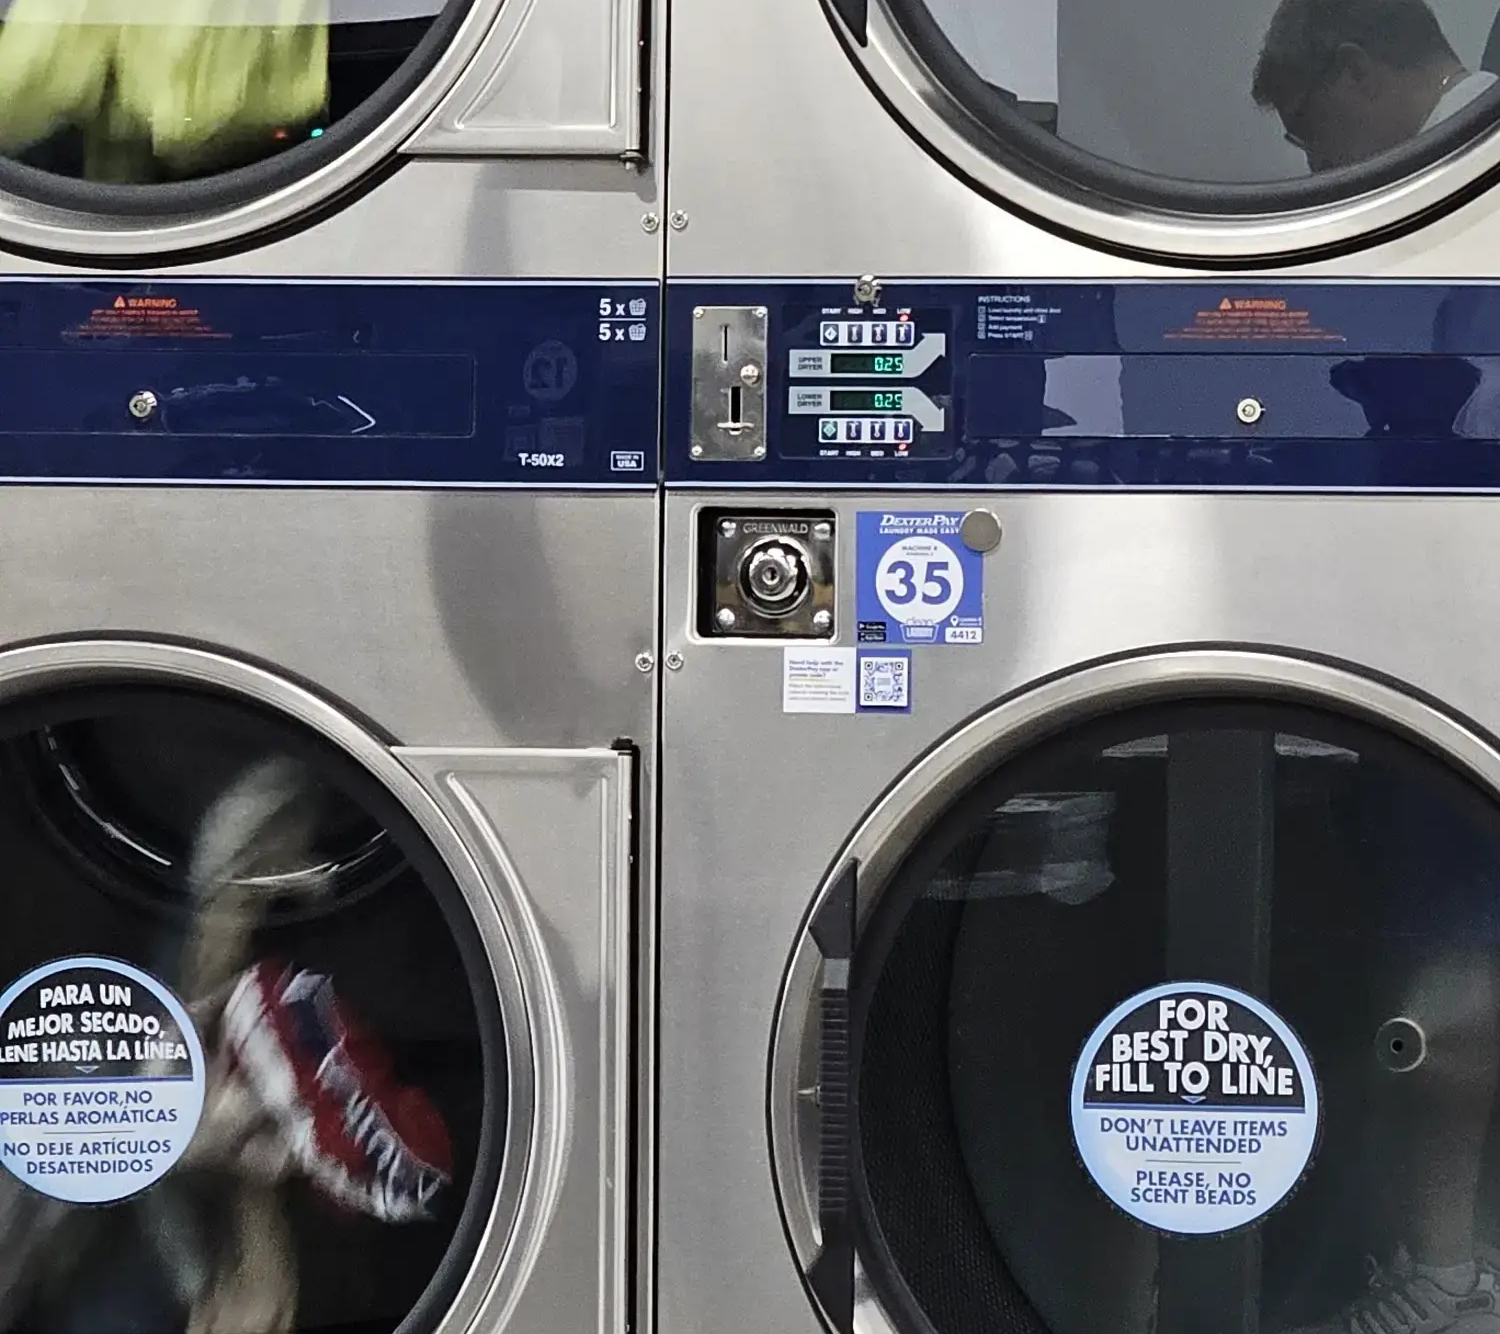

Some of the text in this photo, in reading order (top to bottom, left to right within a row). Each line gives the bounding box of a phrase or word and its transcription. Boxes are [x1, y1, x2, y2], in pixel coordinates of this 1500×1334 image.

[599, 298, 626, 316] 5 x
[598, 323, 625, 341] 5 x
[518, 453, 565, 467] T-50X2
[616, 460, 638, 468] USA
[743, 522, 809, 534] GREENWALD
[885, 561, 952, 605] 35
[950, 630, 977, 640] 4412
[39, 983, 132, 1009] PARA UN
[1159, 999, 1230, 1031] FOR
[7, 1012, 166, 1041] MEJOR SECADO,
[42, 1040, 102, 1063] HASTA
[106, 1039, 133, 1061] LA
[134, 1037, 188, 1061] LÍNEA
[1112, 1030, 1273, 1068] BEST DRY,
[1095, 1061, 1294, 1096] FILL TO LINE
[23, 1092, 57, 1106] POR
[125, 1090, 153, 1104] NO
[0, 1106, 178, 1125] PERLAS AROMÁTICAS
[1170, 1119, 1226, 1136] LEAVE
[1233, 1120, 1288, 1137] ITEMS
[3, 1137, 171, 1156] NO DEJE ARTÍCULOS
[1126, 1137, 1262, 1154] UNATTENDED
[27, 1159, 153, 1175] DESATENDIDOS
[1136, 1170, 1251, 1190] PLEASE, NO
[1130, 1188, 1256, 1206] SCENT BEADS
